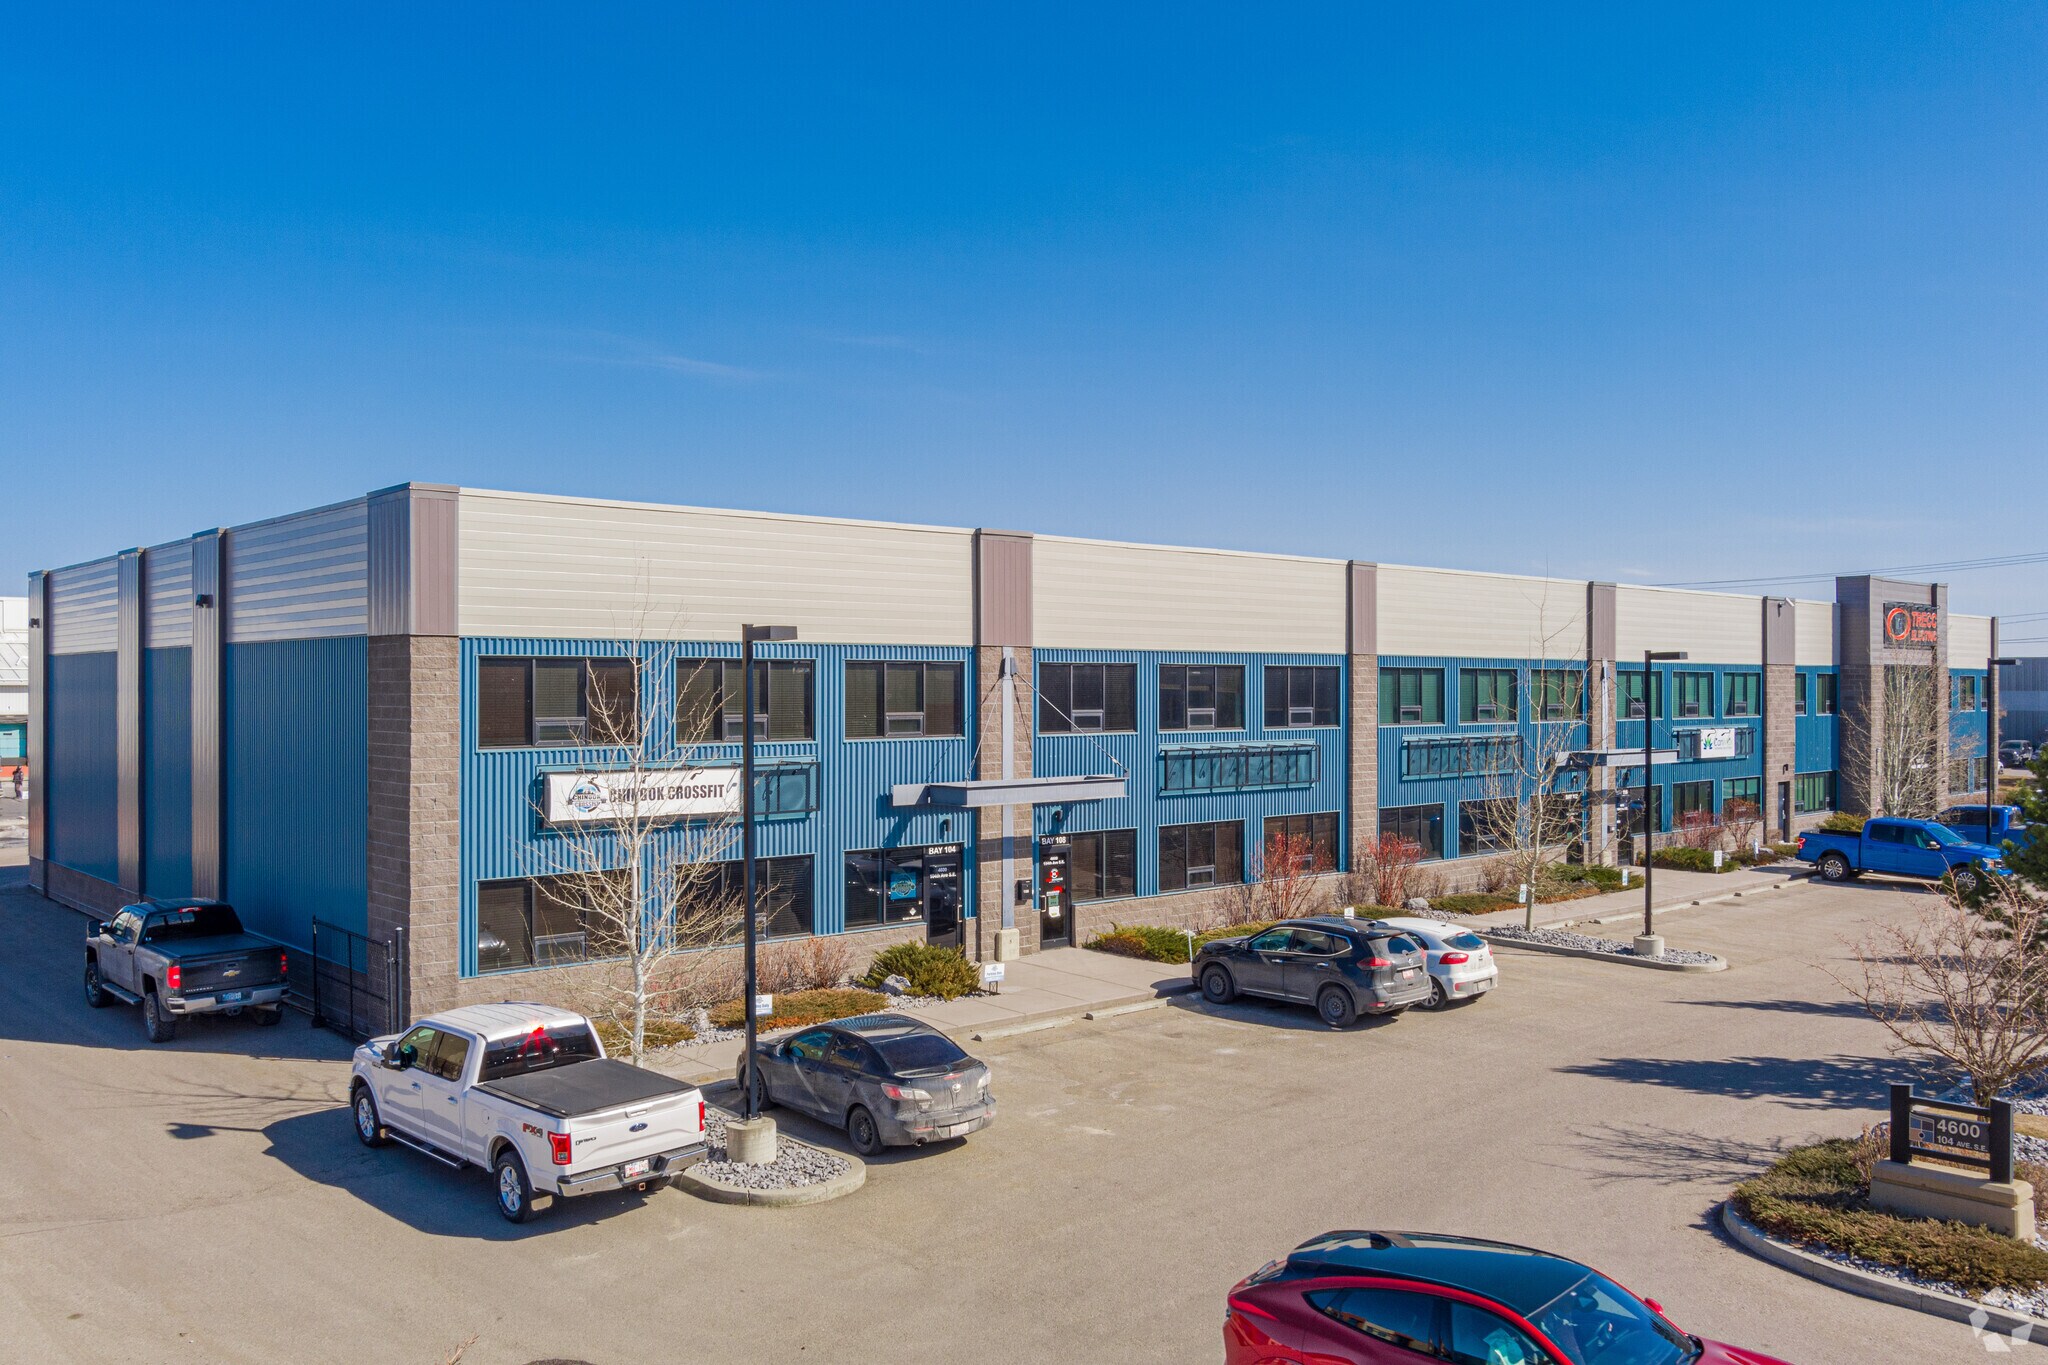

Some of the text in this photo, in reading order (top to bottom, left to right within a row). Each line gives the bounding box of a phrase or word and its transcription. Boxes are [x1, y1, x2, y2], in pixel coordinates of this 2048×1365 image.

[609, 784, 725, 803] CHINOOK CROSSFIT
[1041, 837, 1055, 845] BAY
[928, 847, 943, 855] BAY
[522, 1122, 543, 1137] FX4
[1937, 1119, 1980, 1138] 4600
[1937, 1136, 1988, 1152] 104 AVE. S.E.
